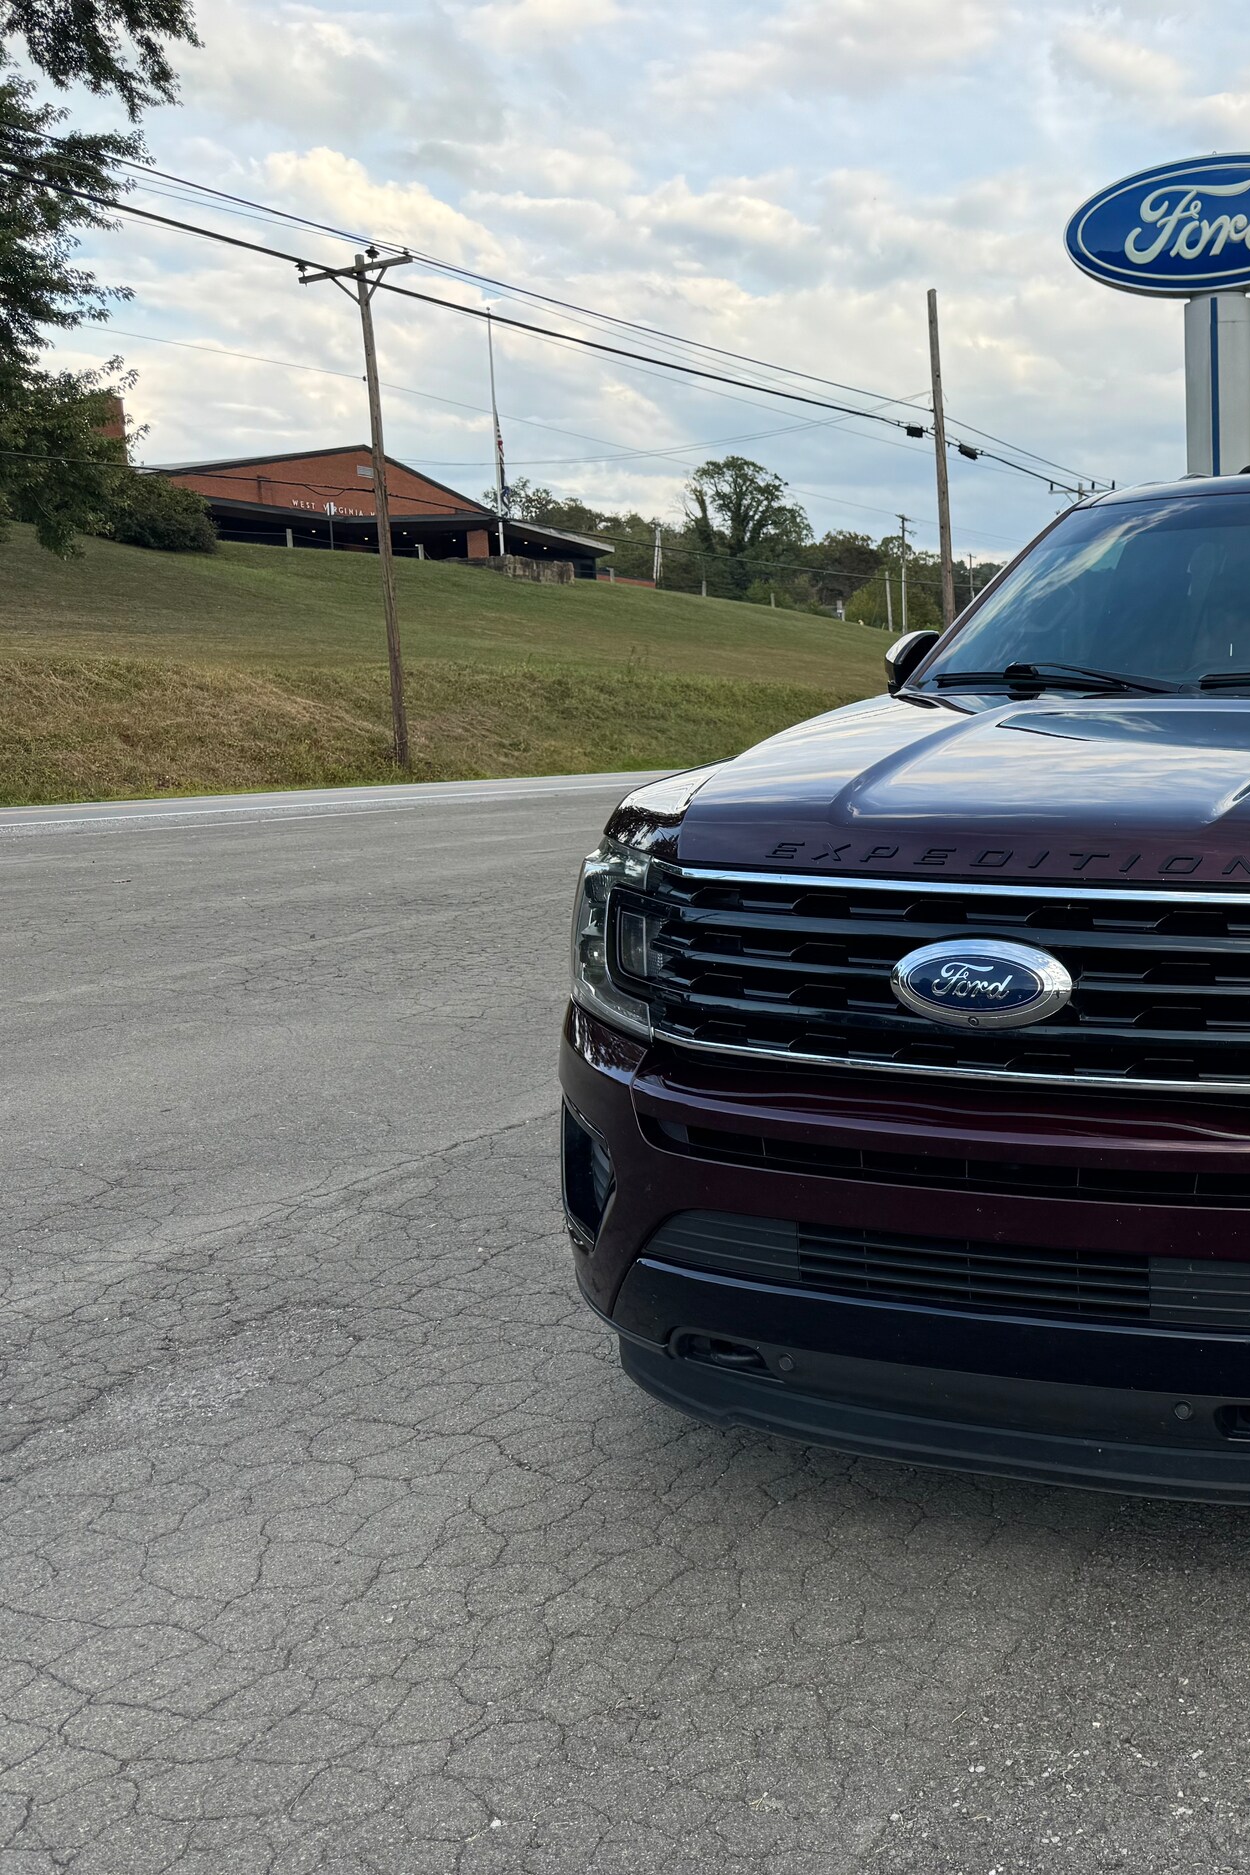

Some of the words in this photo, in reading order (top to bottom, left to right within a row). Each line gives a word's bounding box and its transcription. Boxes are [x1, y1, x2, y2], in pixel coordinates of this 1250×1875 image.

[292, 499, 316, 510] WEST
[323, 504, 364, 517] VRGINIA
[931, 962, 1014, 1000] Ford
